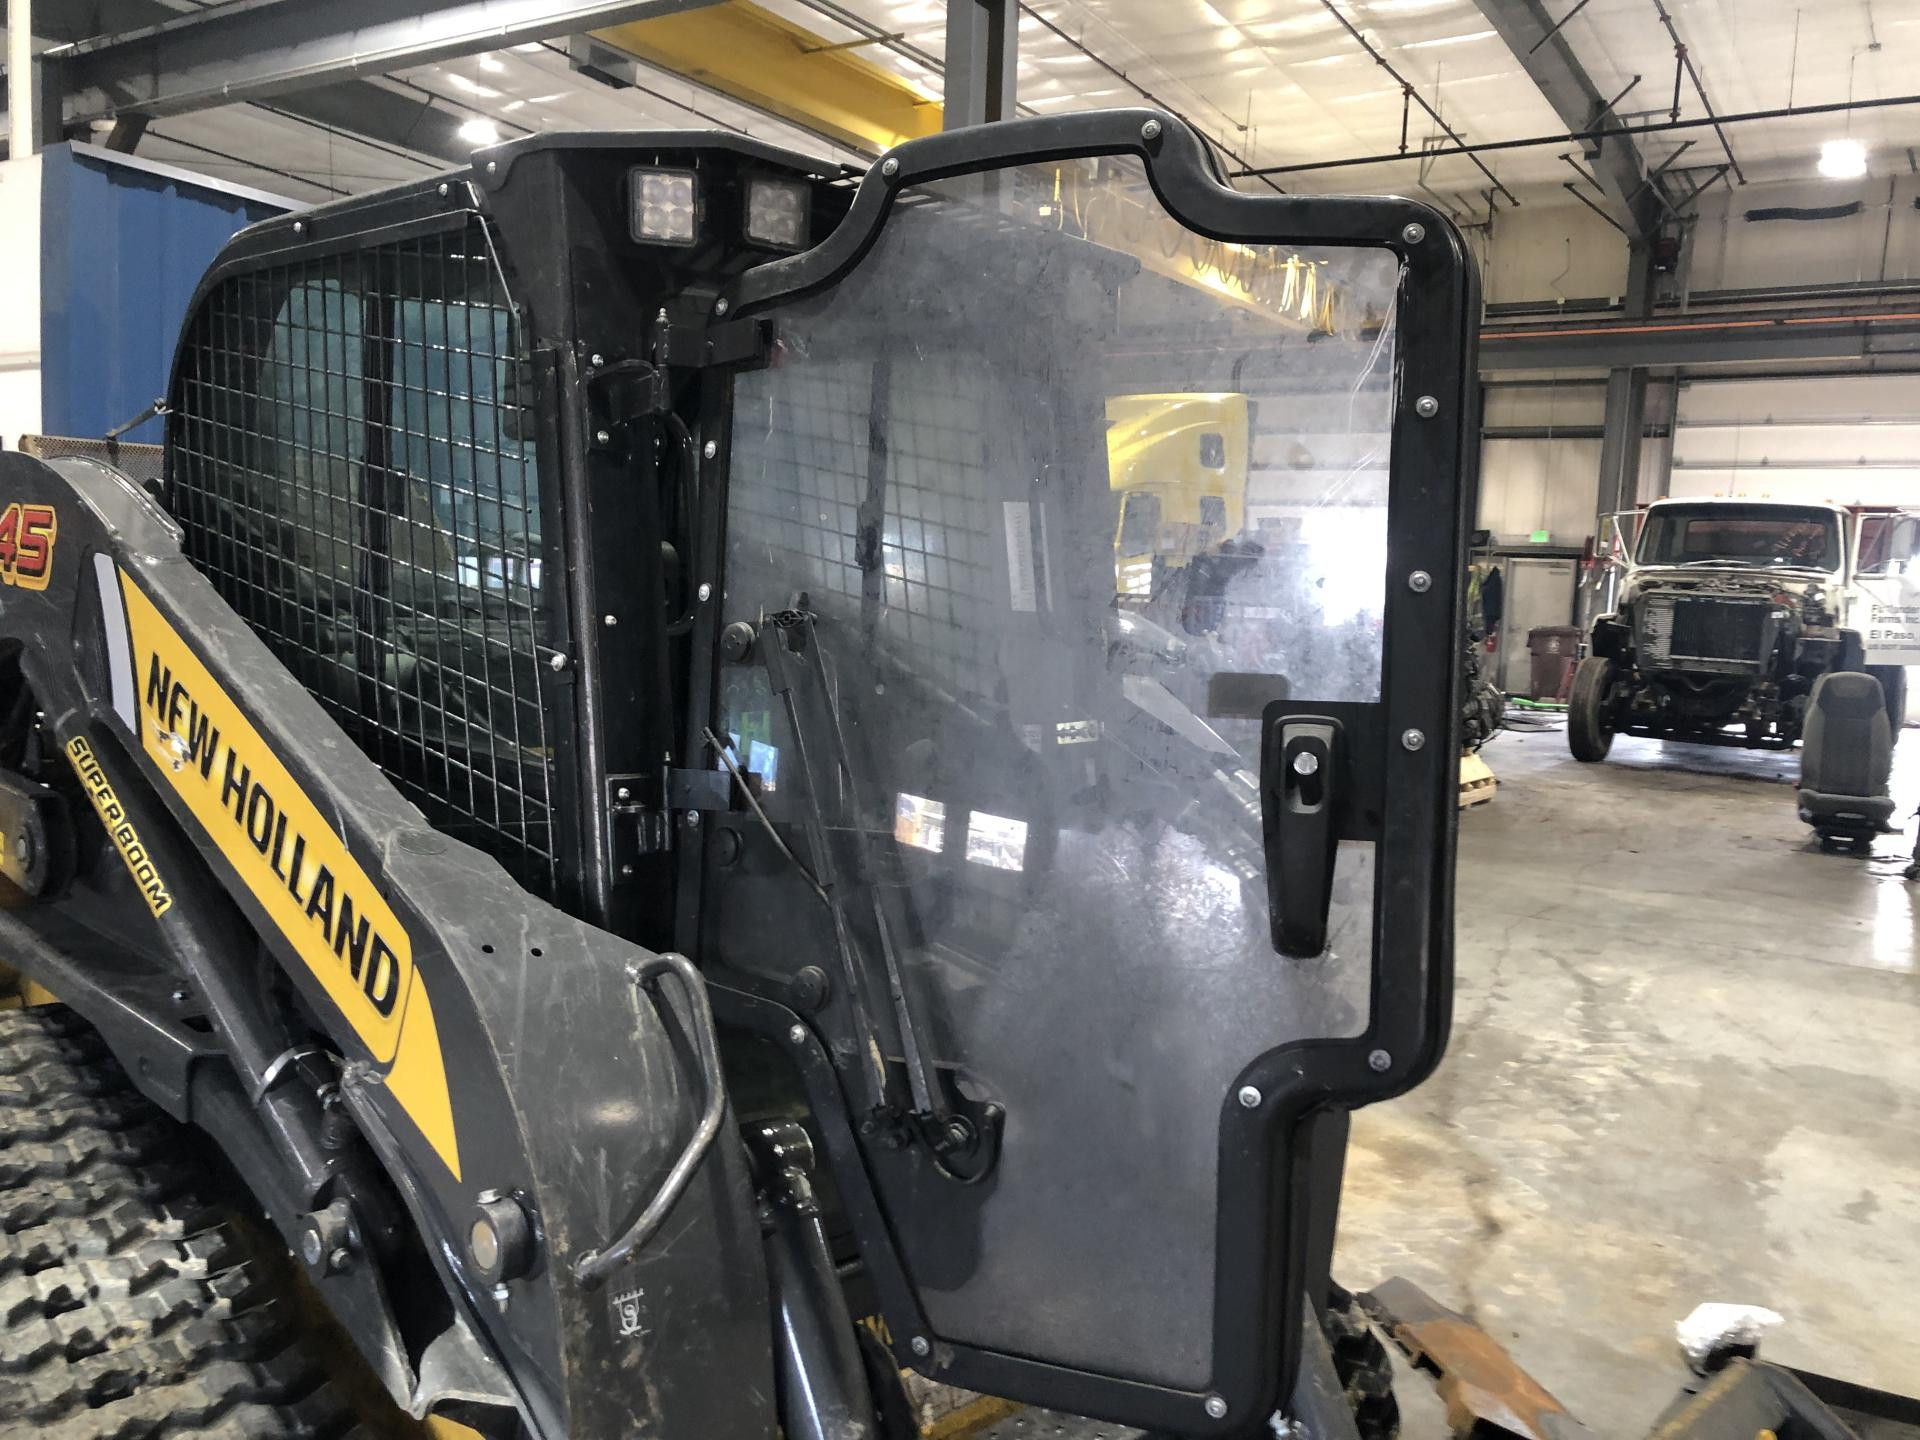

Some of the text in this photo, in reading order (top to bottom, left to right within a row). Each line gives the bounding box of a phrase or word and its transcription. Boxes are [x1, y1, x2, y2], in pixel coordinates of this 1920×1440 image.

[0, 502, 57, 592] 45
[147, 651, 401, 1018] NEW HOLLAND
